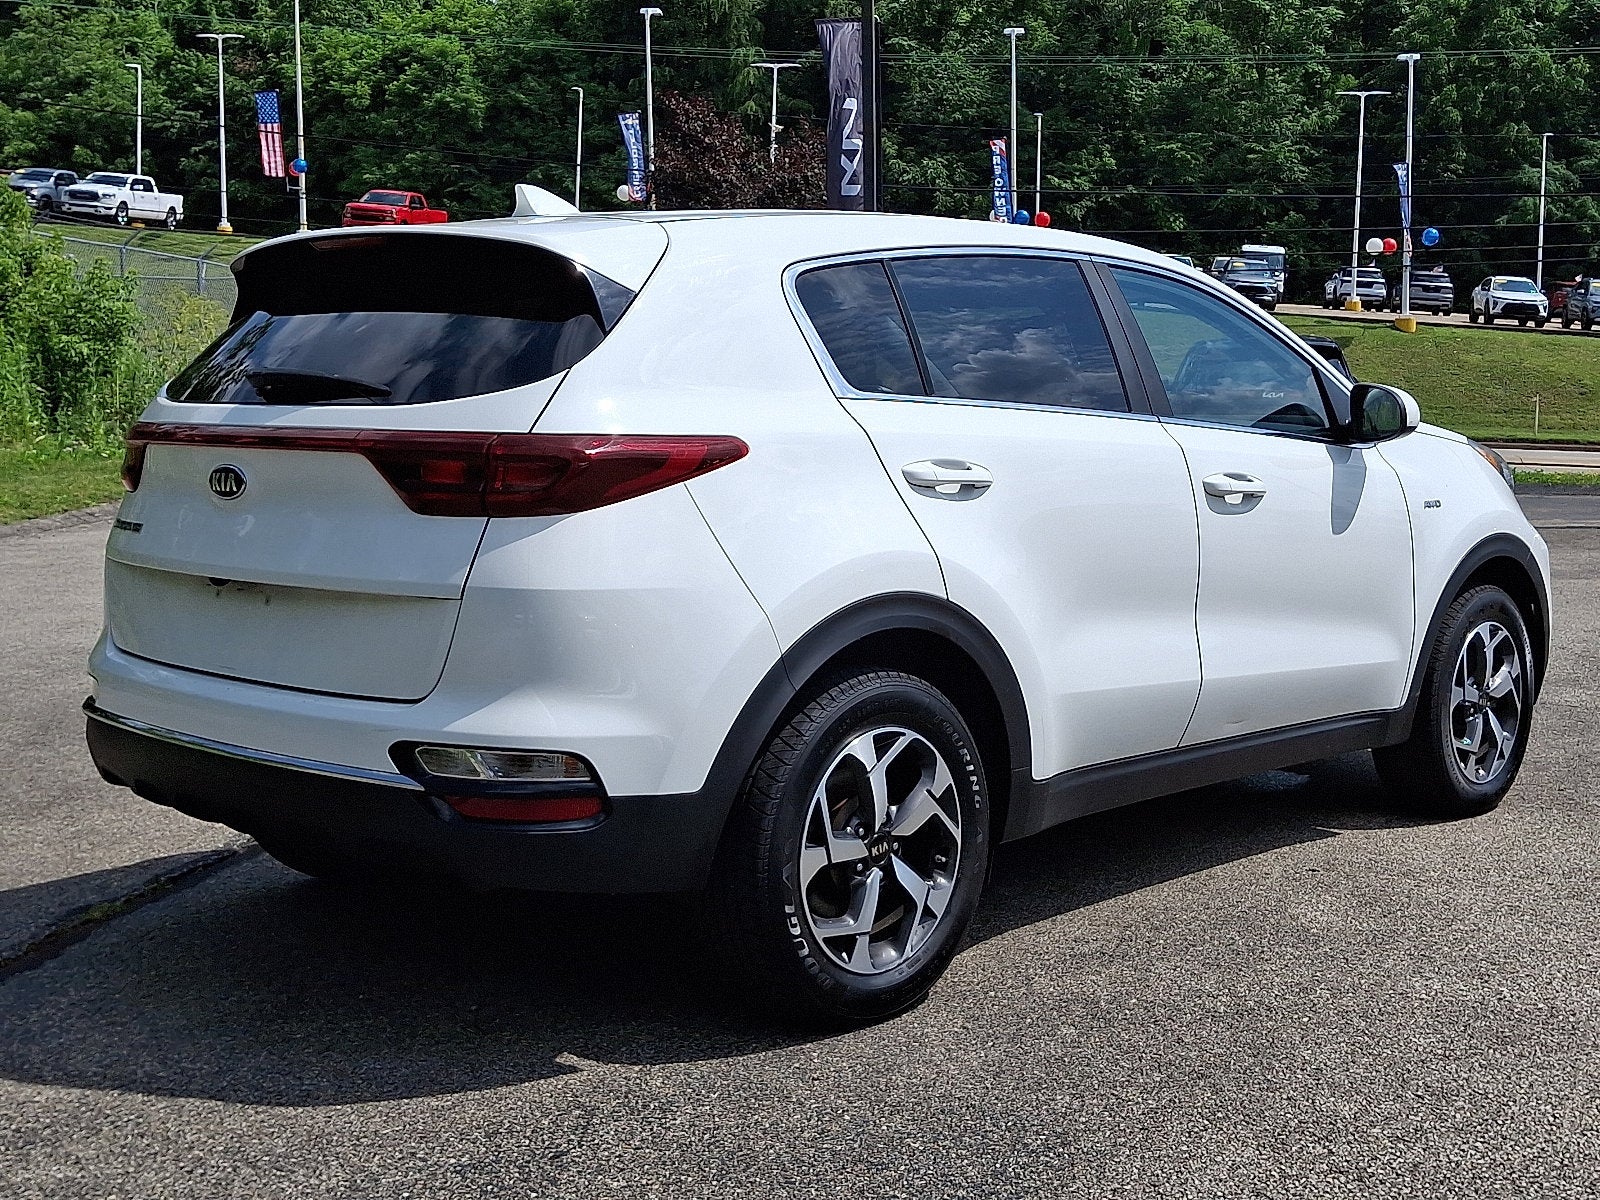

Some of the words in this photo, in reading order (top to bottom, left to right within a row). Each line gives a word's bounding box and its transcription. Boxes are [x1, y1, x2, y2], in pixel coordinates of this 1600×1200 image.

[212, 472, 238, 492] KIA
[934, 713, 982, 809] TOURING
[871, 841, 889, 857] KIA
